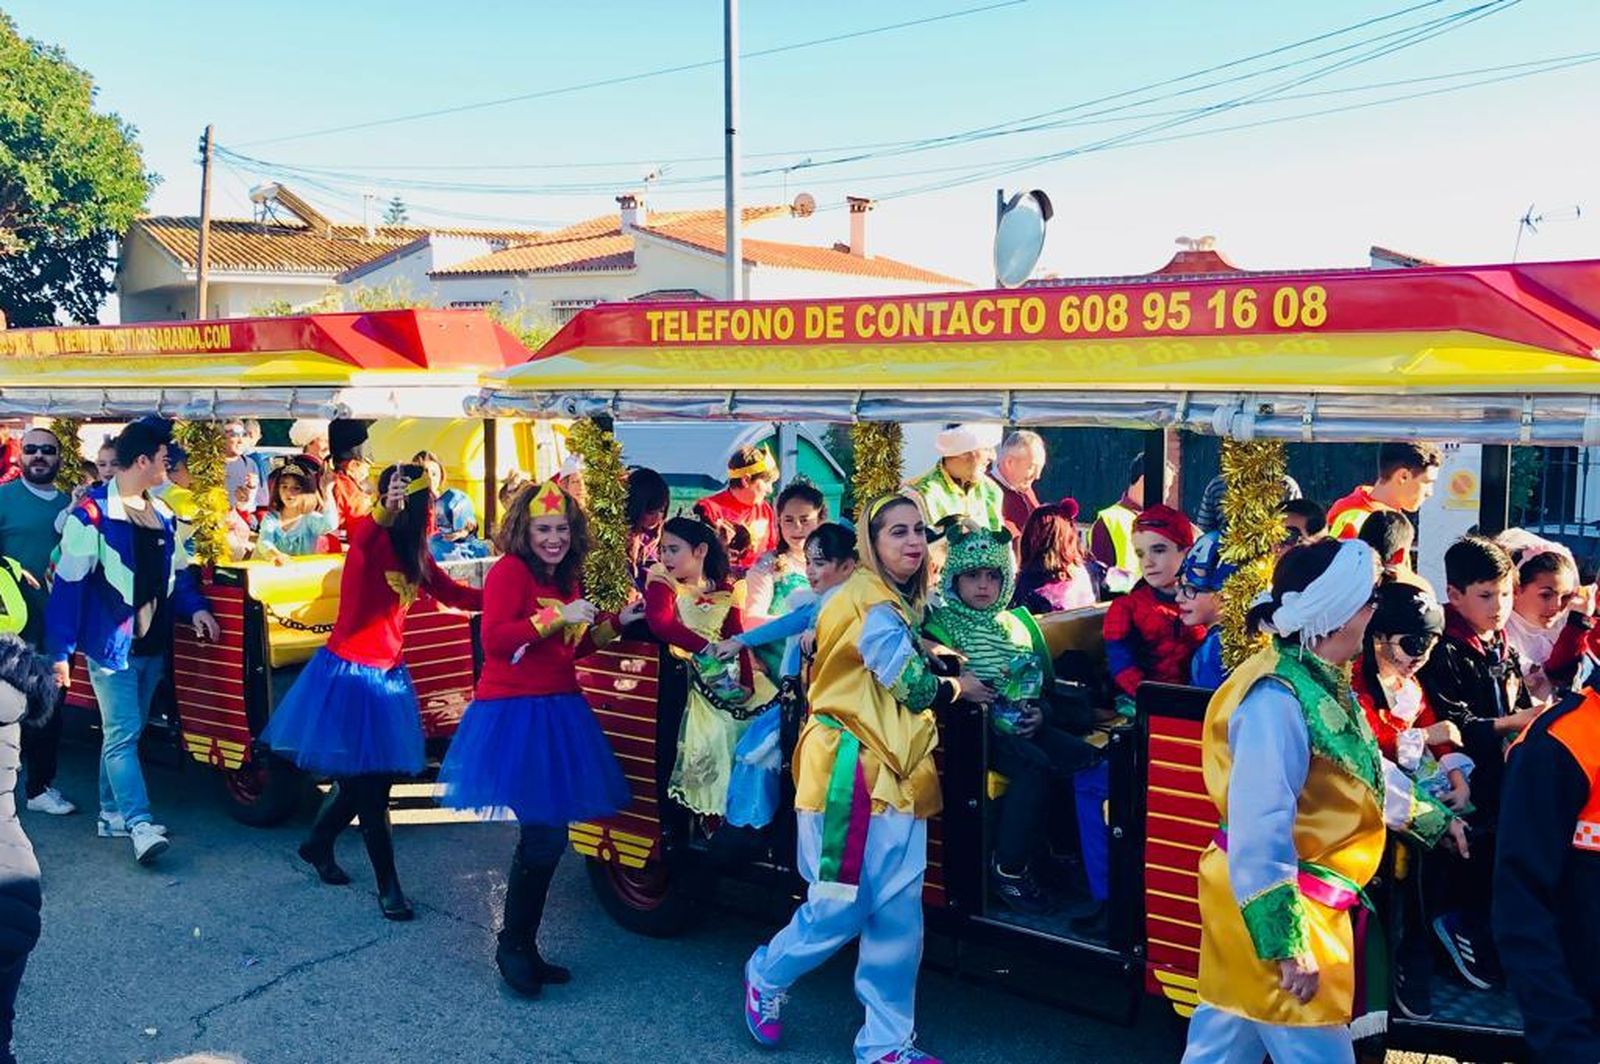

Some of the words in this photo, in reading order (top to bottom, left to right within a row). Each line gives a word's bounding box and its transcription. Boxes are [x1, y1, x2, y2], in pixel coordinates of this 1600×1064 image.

[646, 306, 795, 342] TELEFONO
[805, 304, 845, 339] DE
[856, 297, 1046, 338] CONTACTO
[1058, 293, 1129, 333] 608
[1142, 290, 1192, 331] 95
[1207, 288, 1258, 330] 16
[1272, 285, 1327, 327] 08
